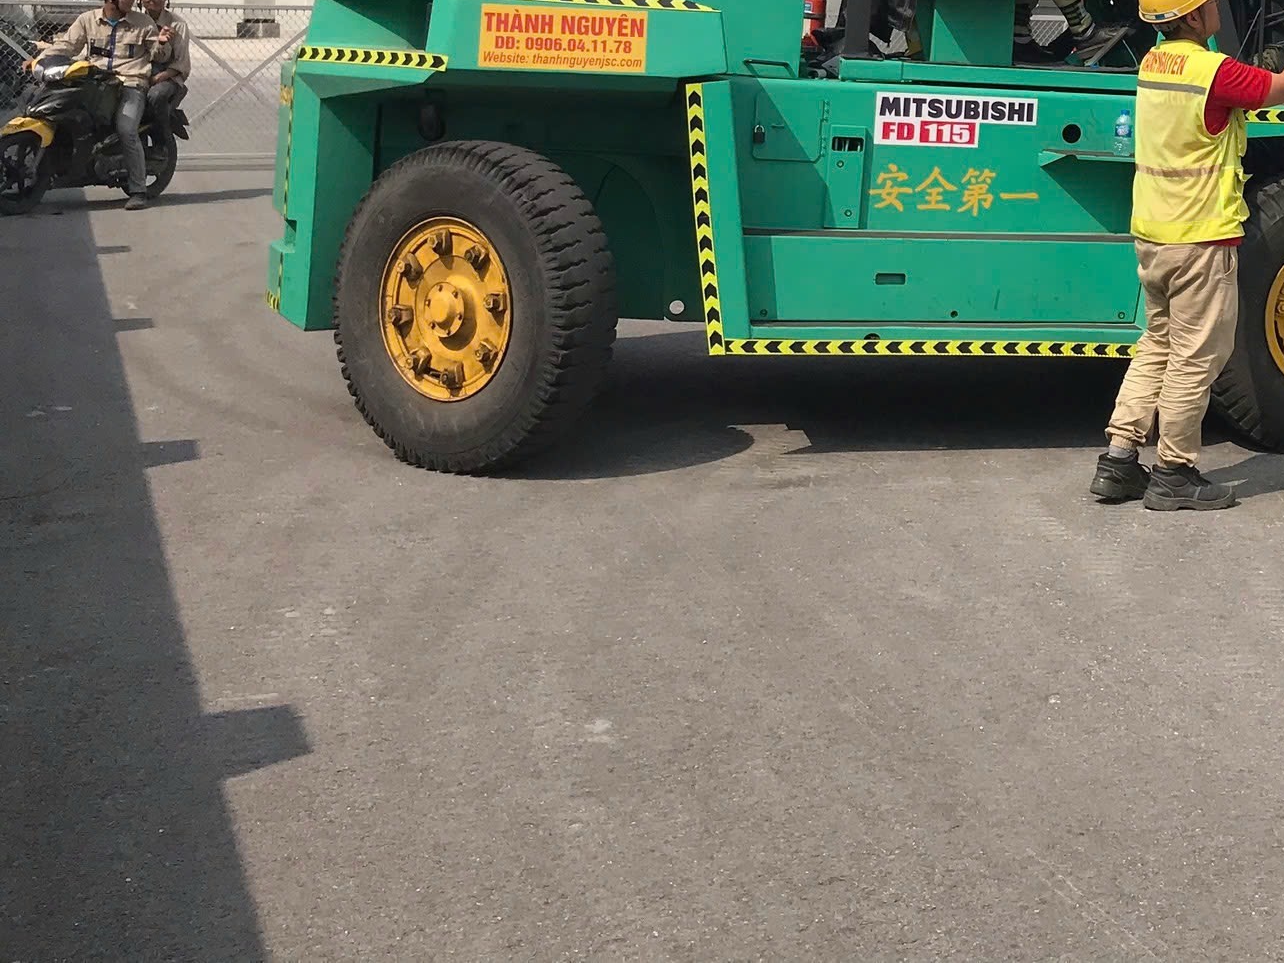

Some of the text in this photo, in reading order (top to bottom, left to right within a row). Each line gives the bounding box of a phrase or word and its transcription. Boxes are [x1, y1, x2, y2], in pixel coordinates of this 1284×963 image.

[484, 8, 645, 38] THÀNH NGUYÊN
[525, 37, 632, 54] 0906.04.11.78
[483, 51, 643, 69] Website: thanhnguyenjsc.com
[879, 96, 1035, 123] MITSUBISHI
[881, 121, 971, 144] FD 115
[868, 163, 1040, 217] 安全第一
